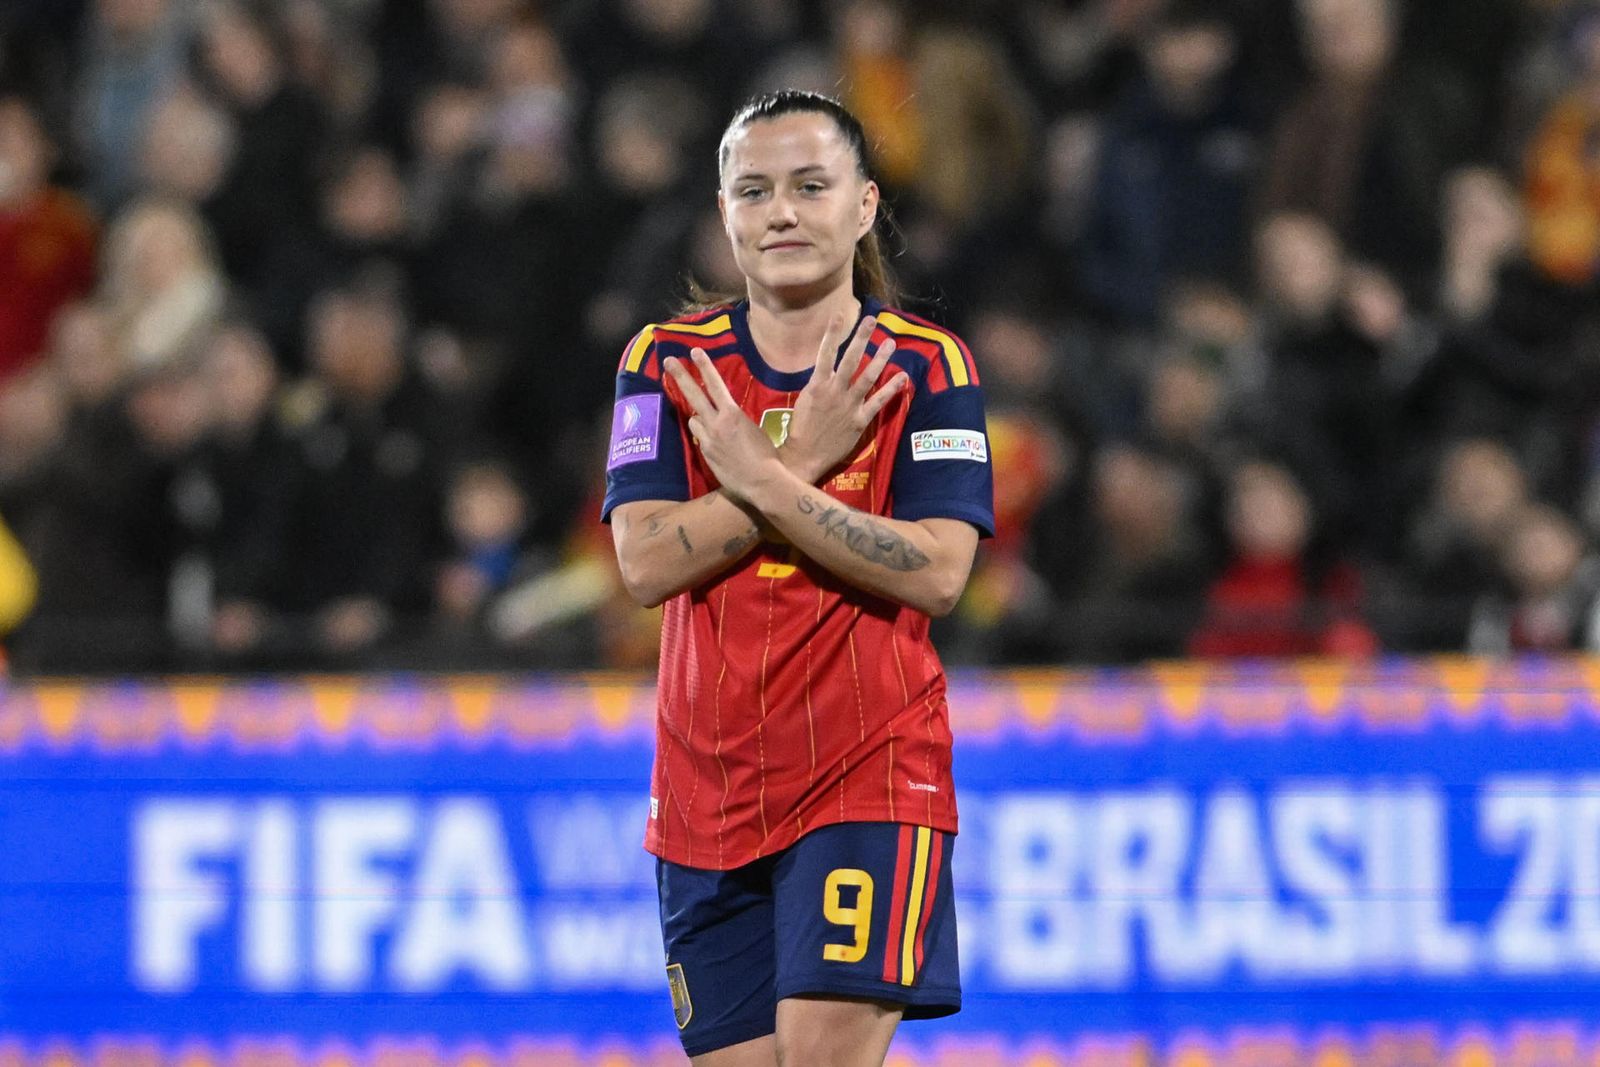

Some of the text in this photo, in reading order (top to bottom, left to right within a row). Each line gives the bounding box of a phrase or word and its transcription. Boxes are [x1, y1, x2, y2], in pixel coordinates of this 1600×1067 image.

[611, 445, 651, 461] QUALIFIERS
[914, 439, 985, 450] FOUNDATION
[132, 796, 531, 992] FIFA
[998, 786, 1476, 984] BRASIL
[823, 868, 874, 963] 9
